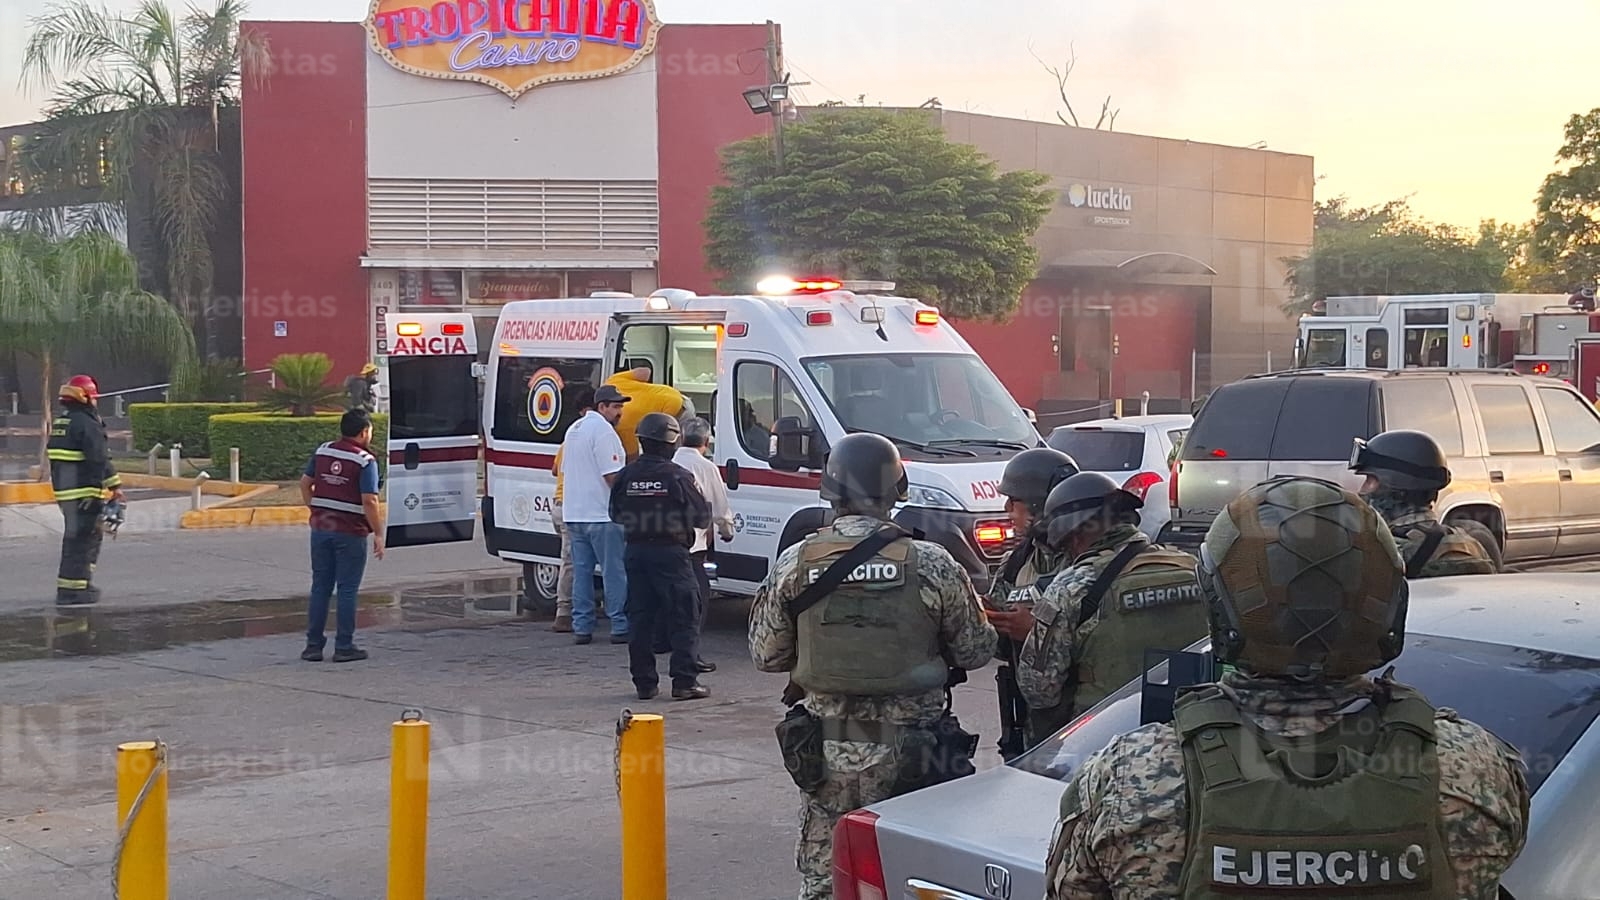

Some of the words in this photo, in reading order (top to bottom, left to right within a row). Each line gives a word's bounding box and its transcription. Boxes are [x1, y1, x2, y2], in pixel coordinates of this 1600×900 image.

[450, 30, 581, 72] Casino
[1087, 184, 1132, 211] luckia
[478, 281, 551, 298] Bienvenidos
[545, 320, 599, 341] AVANZADAS
[631, 481, 662, 489] SSPC
[808, 563, 898, 584] ECITO
